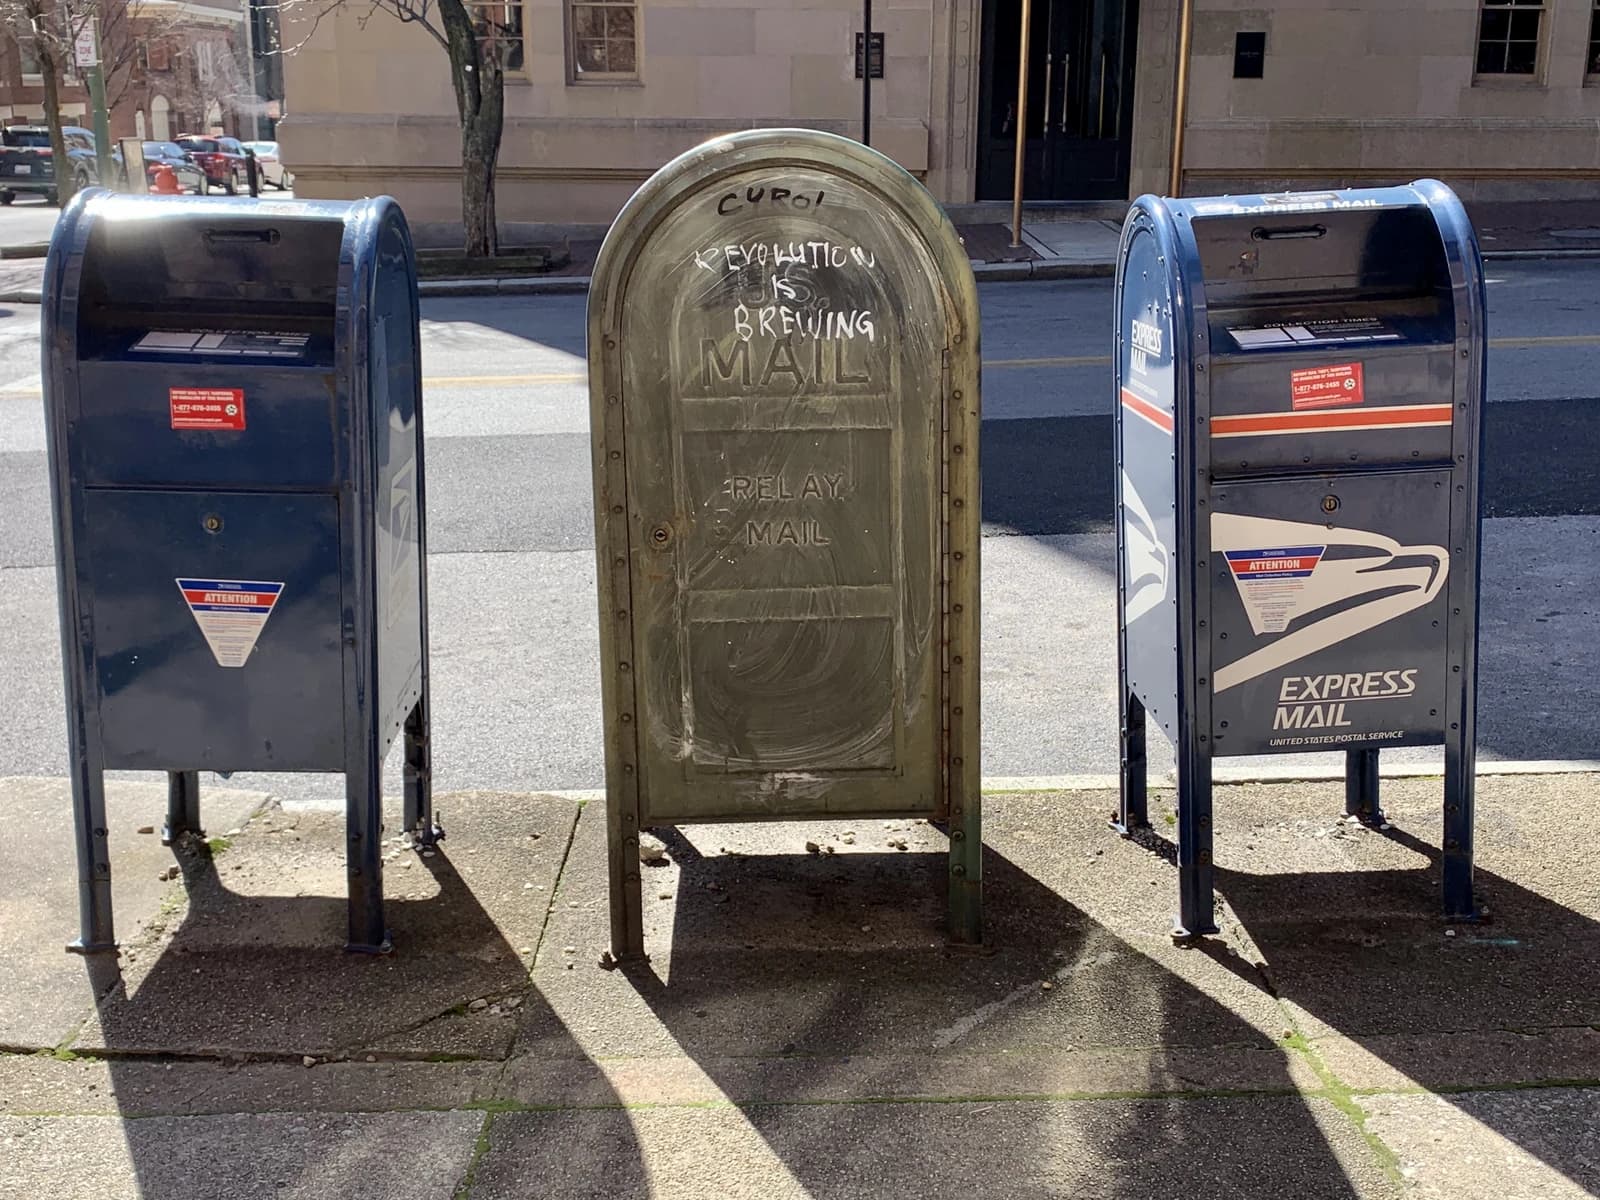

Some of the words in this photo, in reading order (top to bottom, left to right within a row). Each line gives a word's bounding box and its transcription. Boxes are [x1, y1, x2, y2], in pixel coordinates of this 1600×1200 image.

[1332, 198, 1384, 209] MAIL
[771, 274, 797, 300] IS
[733, 302, 876, 343] BREWING
[1131, 319, 1162, 355] EXPRESS
[701, 337, 871, 390] MAIL
[731, 473, 843, 503] RELAY
[746, 518, 832, 546] MAIL
[1249, 559, 1301, 571] ATTENTION
[203, 592, 258, 604] ATTENTION
[1279, 669, 1419, 701] EXPRESS
[1272, 703, 1352, 731] MAIL
[1269, 736, 1303, 747] UNITED
[1303, 735, 1335, 745] STATES
[1335, 732, 1367, 743] POSTAL
[1368, 730, 1405, 740] SERVICE
